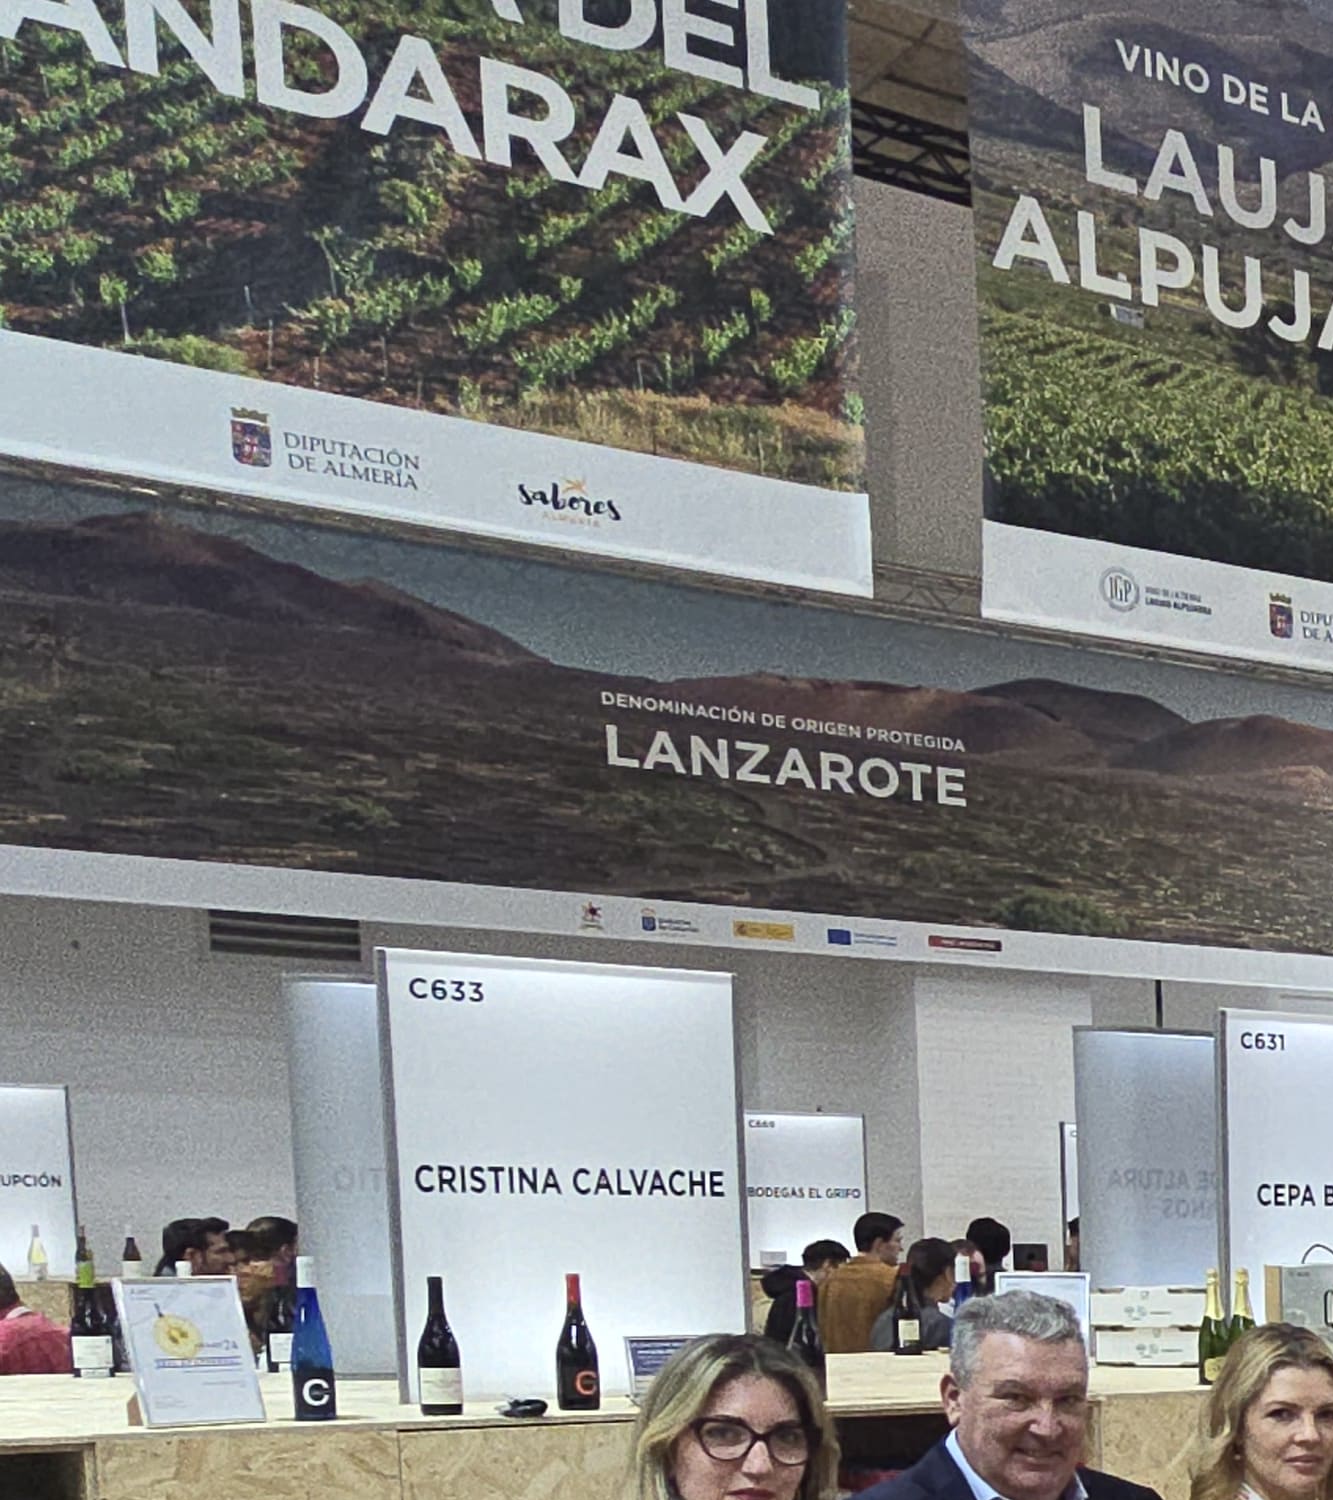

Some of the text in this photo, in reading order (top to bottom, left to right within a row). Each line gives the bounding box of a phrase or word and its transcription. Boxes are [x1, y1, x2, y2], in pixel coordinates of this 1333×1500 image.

[1115, 38, 1210, 95] VINO
[1222, 73, 1269, 114] DE
[1281, 92, 1325, 133] LA
[0, 0, 772, 235] ANDARAX
[283, 431, 420, 470] DIPUTACIÓN
[287, 453, 419, 491] DE ALMERÍA
[518, 482, 621, 521] sabores
[1109, 575, 1132, 602] IGP
[1303, 626, 1321, 641] DE
[601, 691, 966, 753] DENOMINACIÓN DE ORIGEN PROTEGIDA
[605, 723, 968, 808] LANZAROTE
[408, 977, 485, 1003] C633
[1240, 1031, 1286, 1052] C631
[414, 1164, 726, 1198] CRISTINA CALVACHE
[1257, 1183, 1316, 1208] CEPA
[302, 1378, 331, 1406] C
[574, 1370, 598, 1396] C
